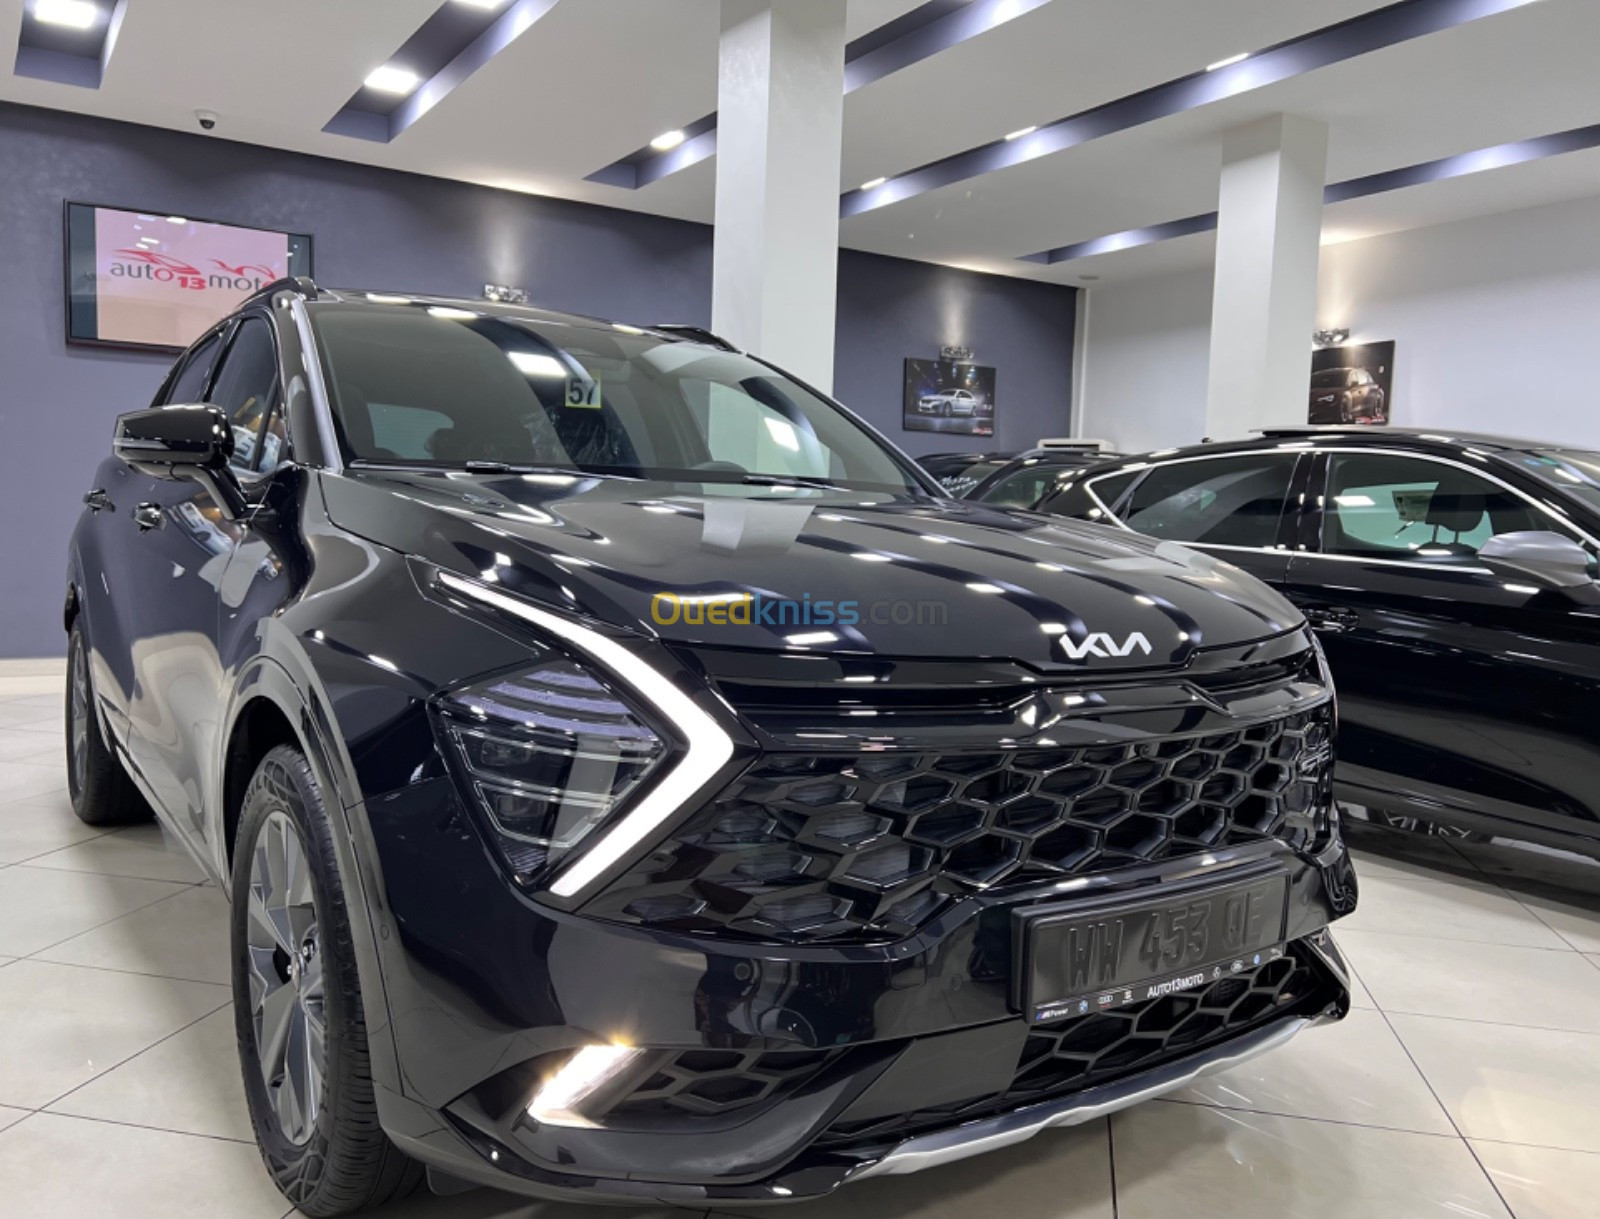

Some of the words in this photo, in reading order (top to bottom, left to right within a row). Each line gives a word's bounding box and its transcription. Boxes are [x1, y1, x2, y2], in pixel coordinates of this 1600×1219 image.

[568, 378, 598, 405] 57
[1067, 919, 1125, 994] WW
[1138, 900, 1212, 972] 453
[1147, 973, 1204, 998] AUTO13MOTO
